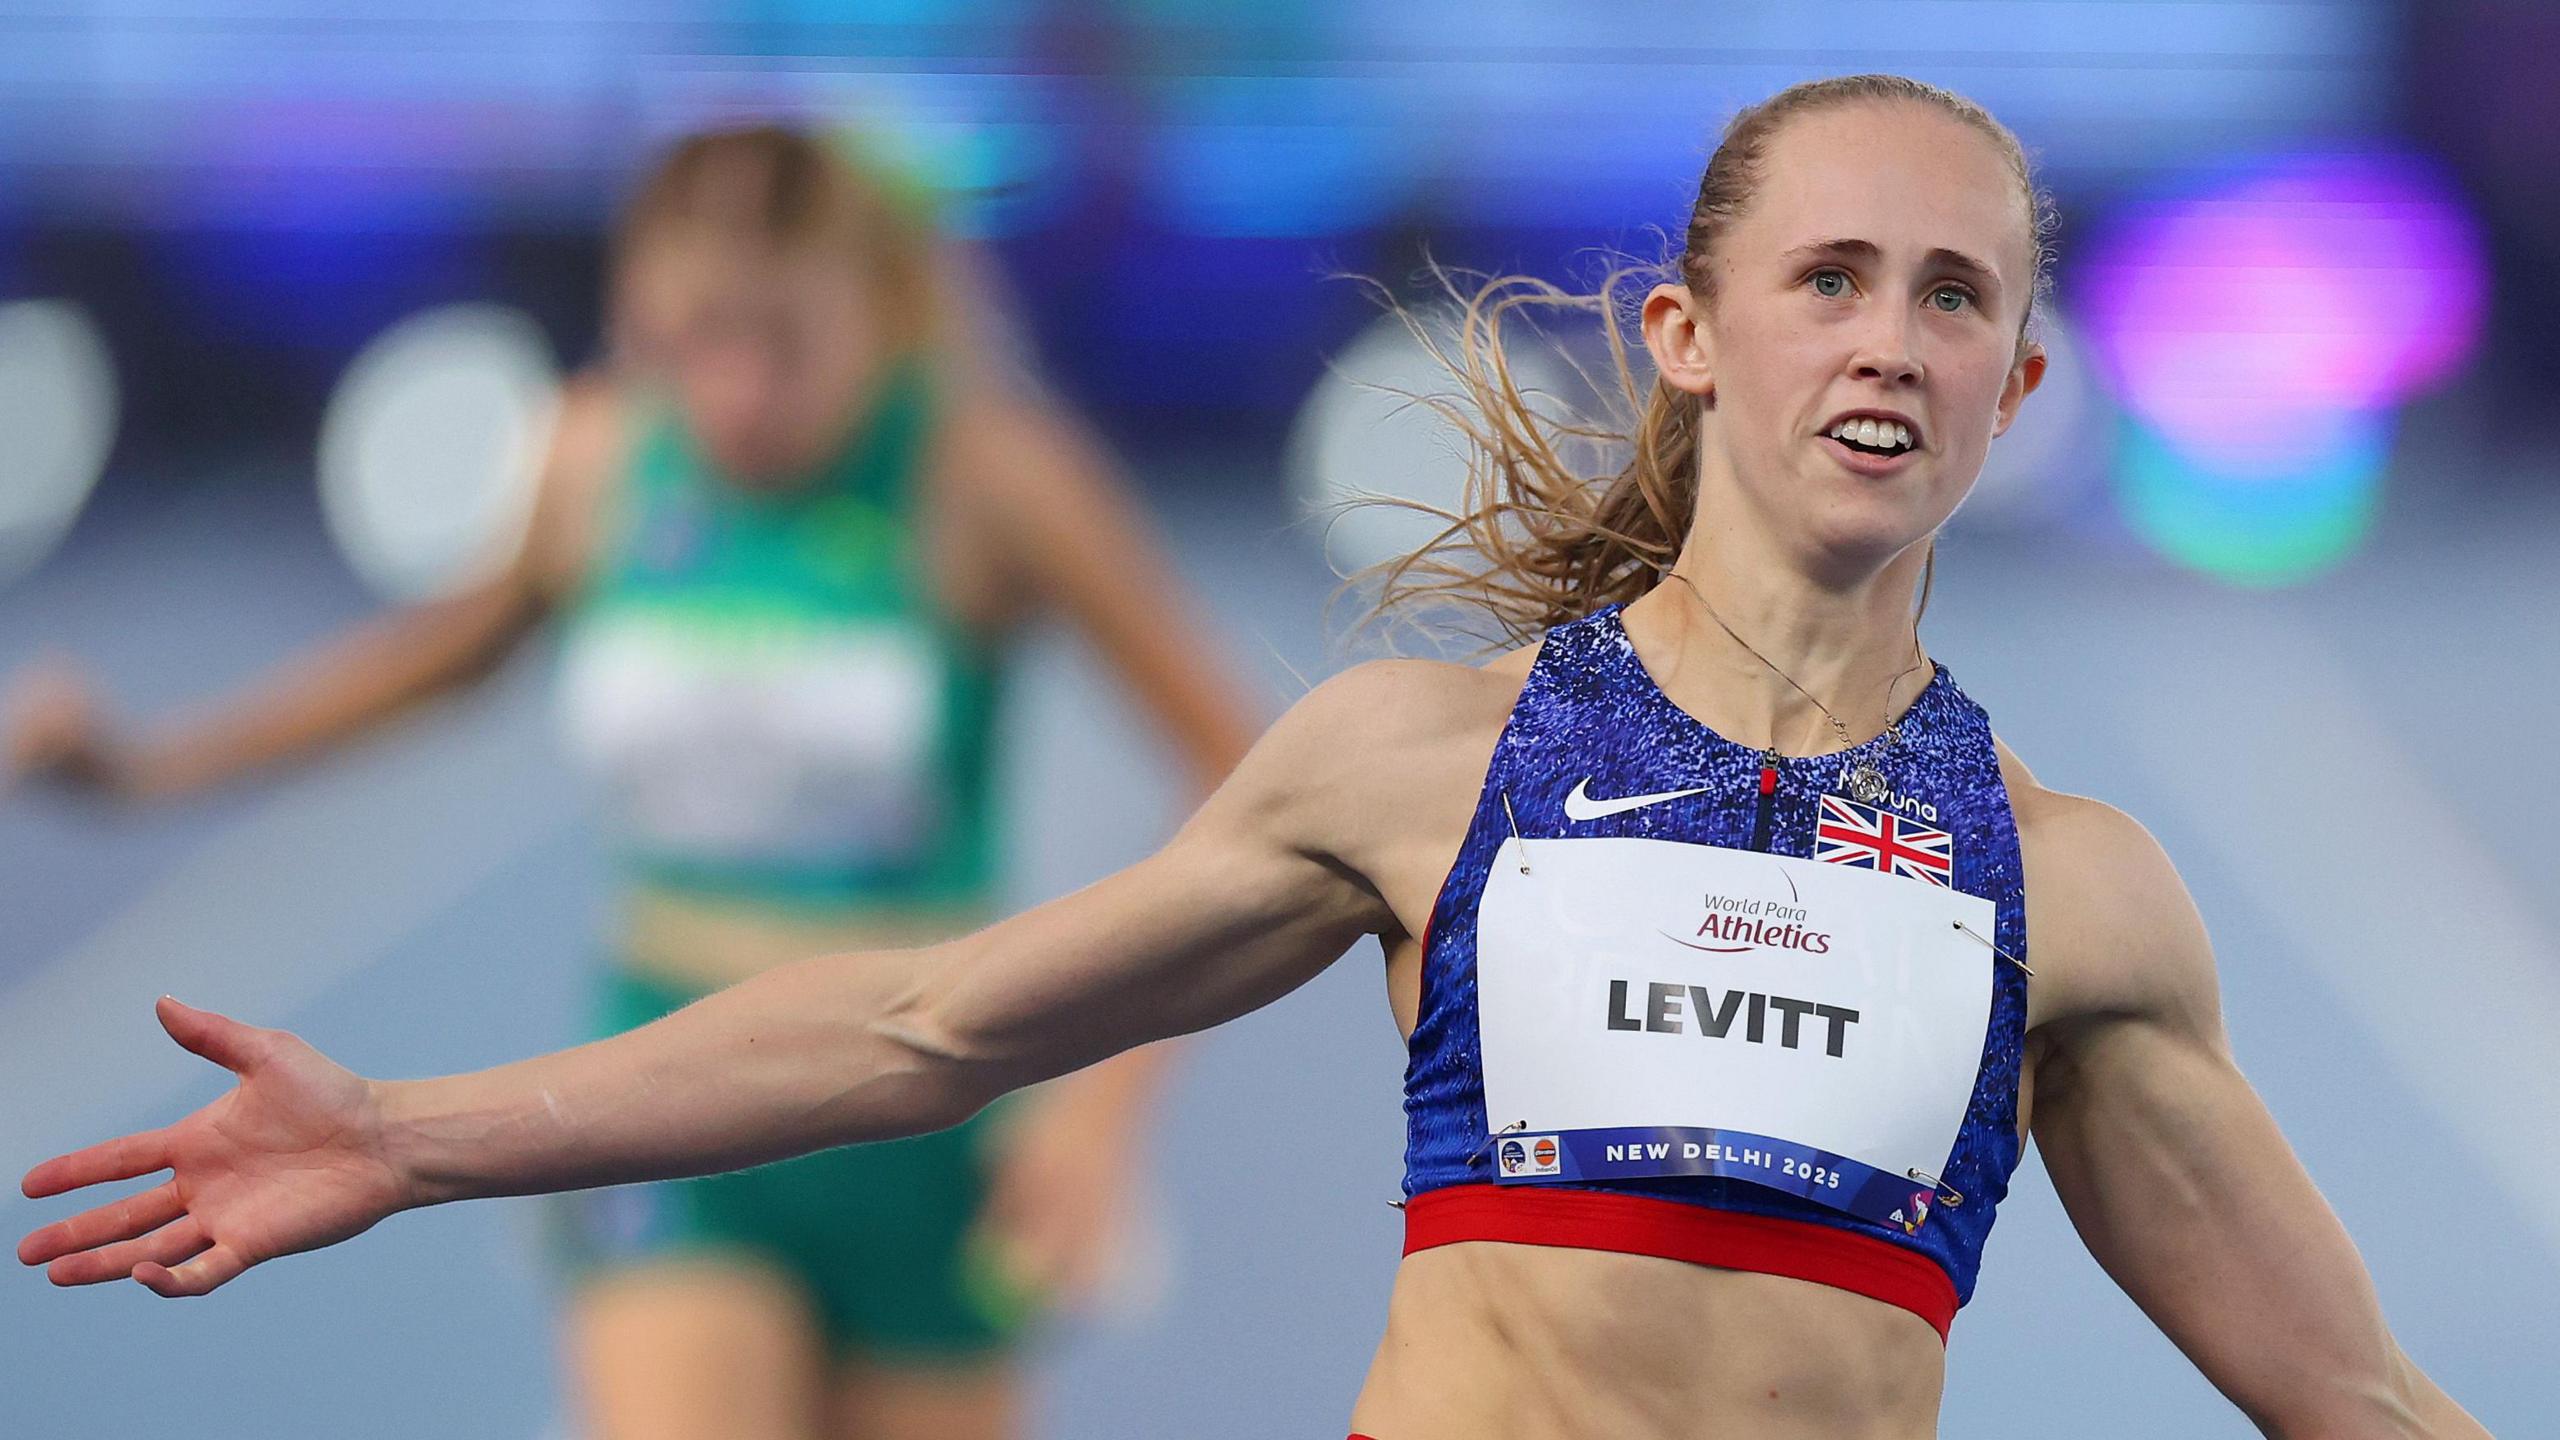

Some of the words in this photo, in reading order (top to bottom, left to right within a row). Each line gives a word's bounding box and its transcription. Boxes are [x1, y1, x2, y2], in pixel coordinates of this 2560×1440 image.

[1837, 768, 1937, 823] Nvuna
[1704, 893, 1761, 915] World
[1764, 902, 1808, 922] Para
[1696, 913, 1832, 954] Athletics
[1607, 979, 1860, 1059] LEVITT
[1606, 1143, 1670, 1162] NEW
[1682, 1143, 1772, 1169] DELHI
[1782, 1158, 1841, 1190] 2025
